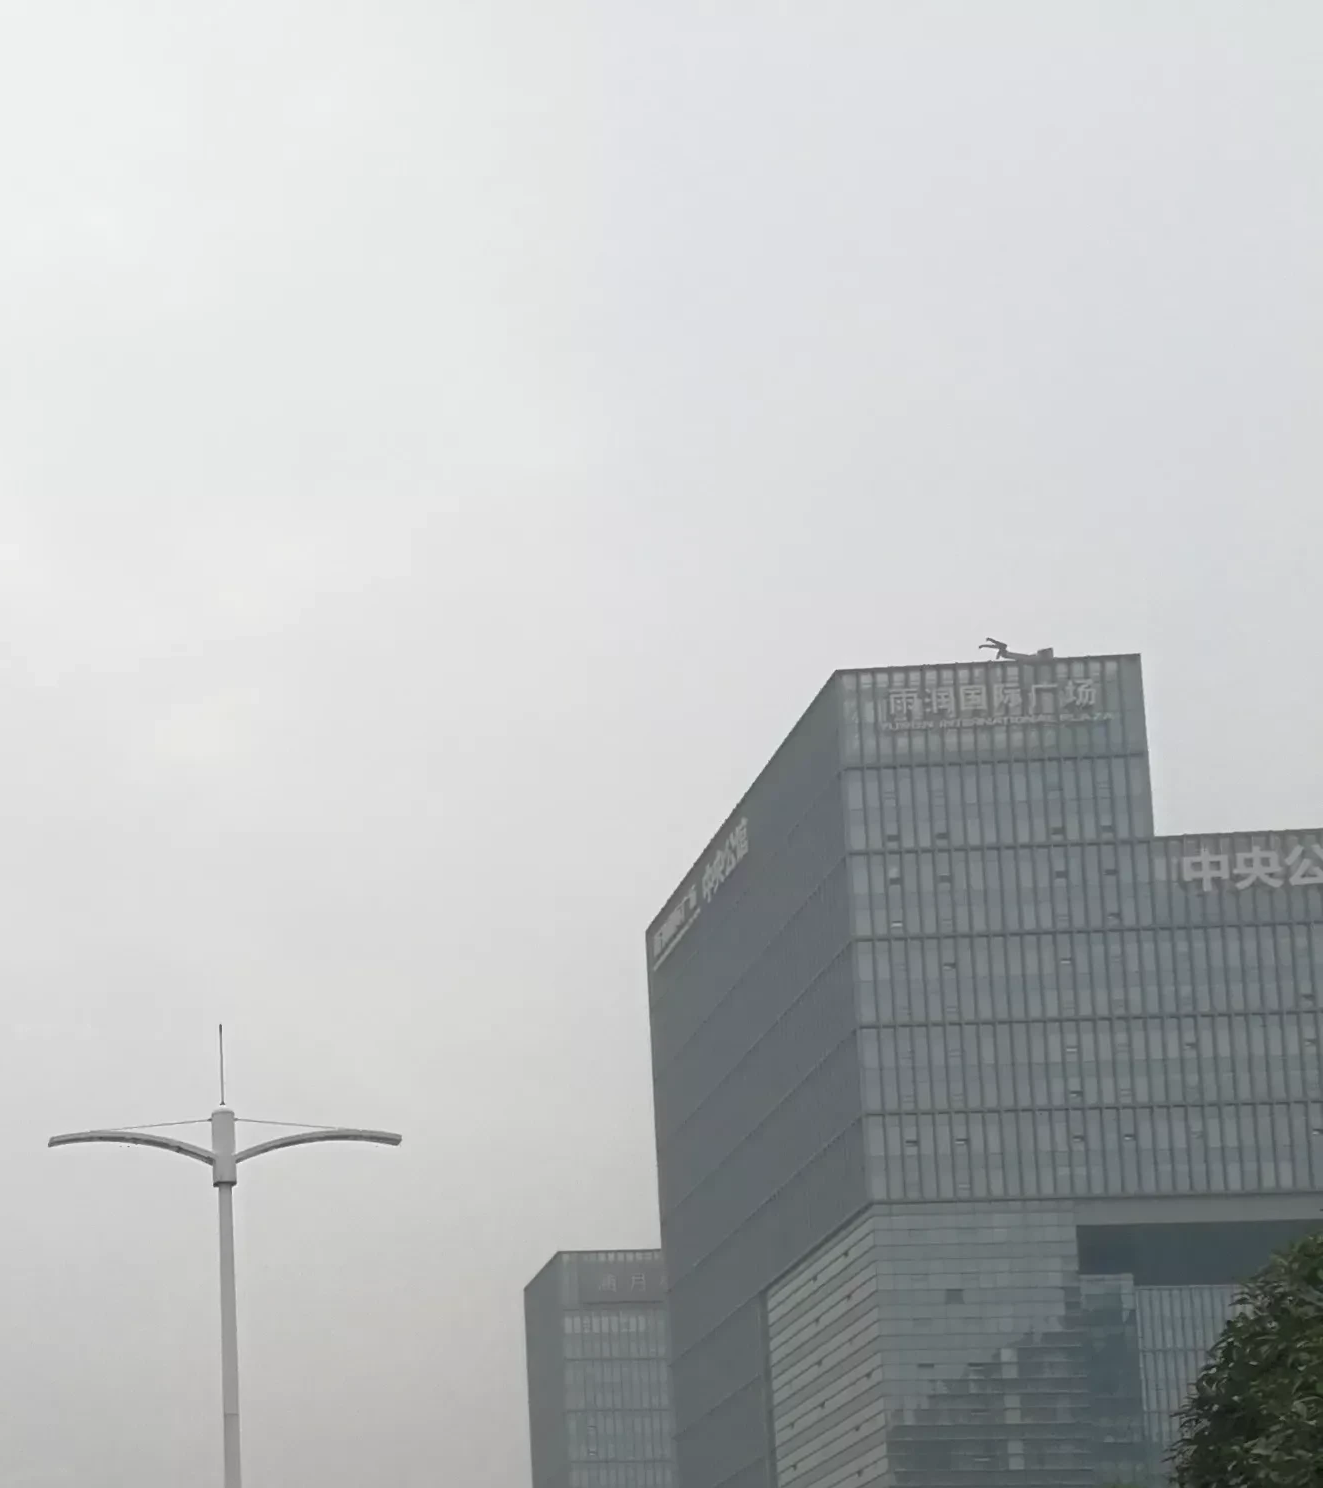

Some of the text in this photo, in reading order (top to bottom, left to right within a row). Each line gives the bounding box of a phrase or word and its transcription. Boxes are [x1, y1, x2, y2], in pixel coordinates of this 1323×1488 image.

[888, 679, 1097, 715] 雨润国际广场
[1182, 844, 1323, 892] 中央公
